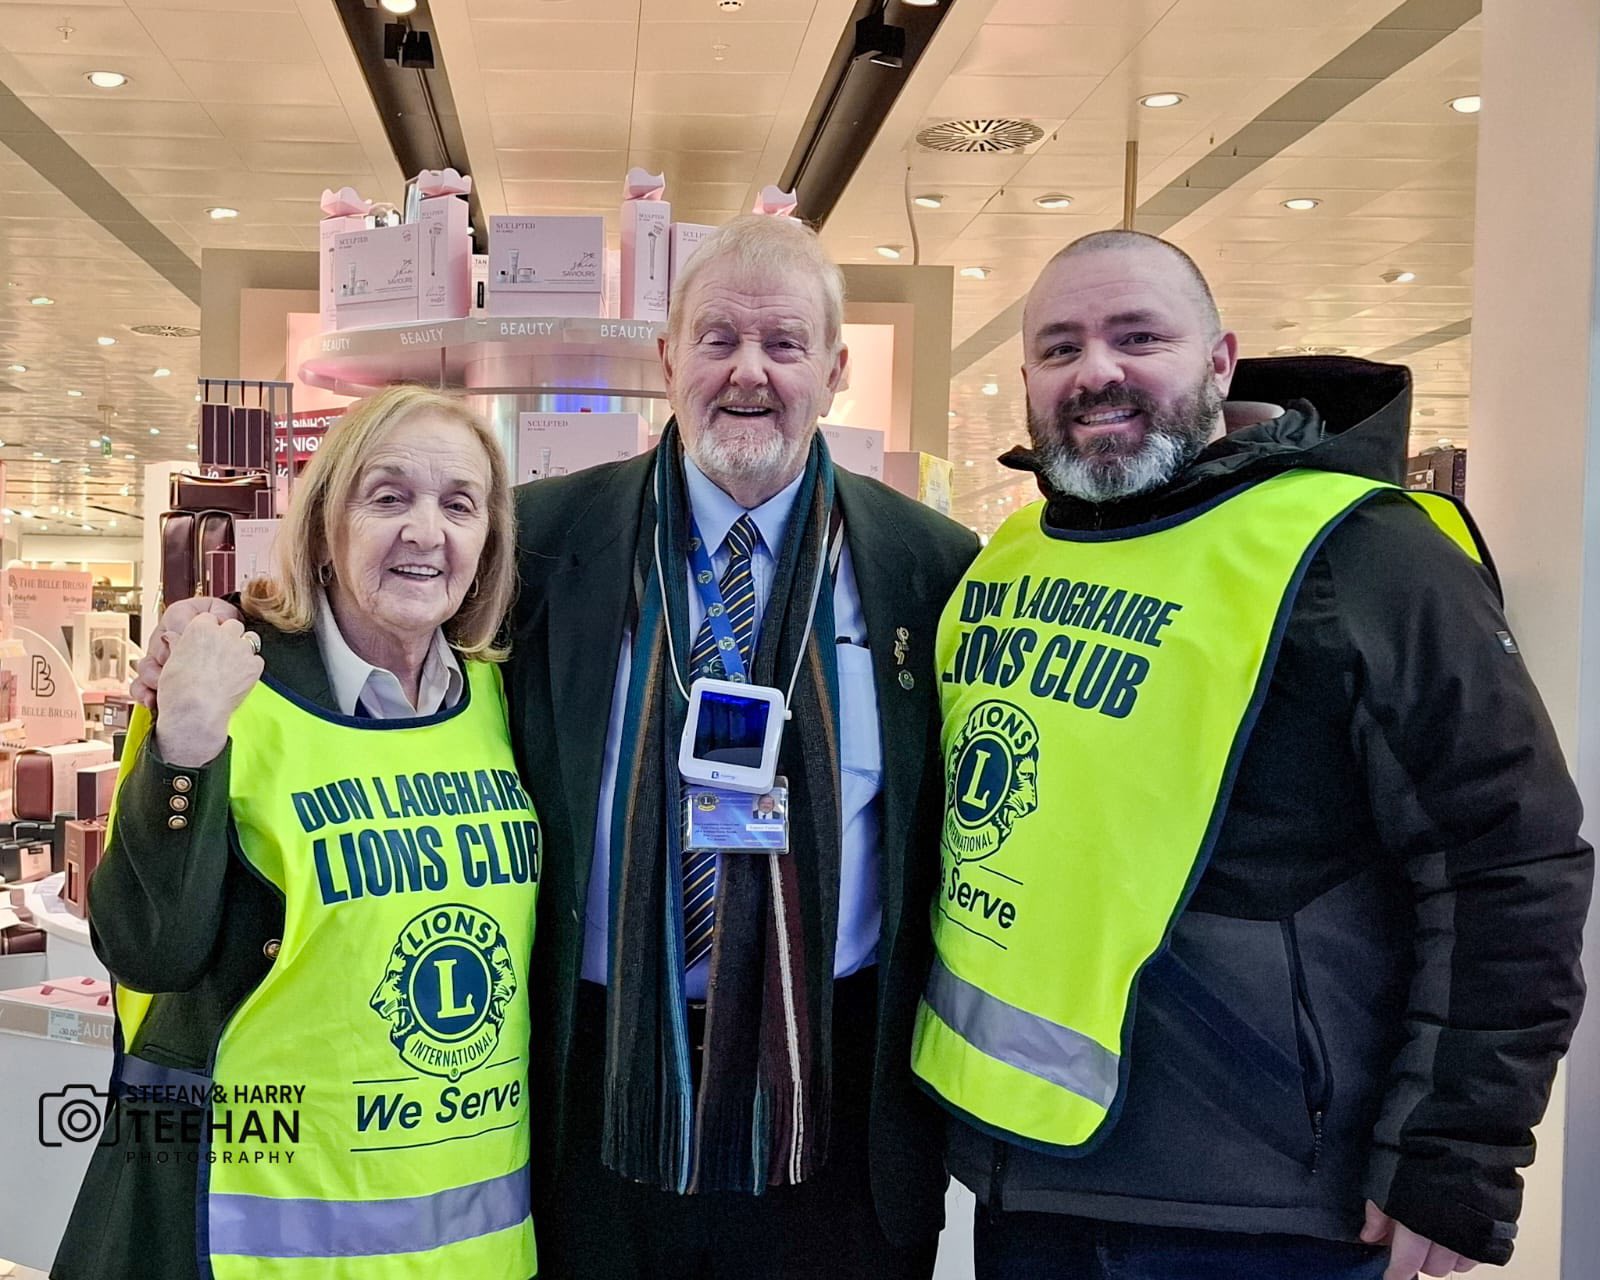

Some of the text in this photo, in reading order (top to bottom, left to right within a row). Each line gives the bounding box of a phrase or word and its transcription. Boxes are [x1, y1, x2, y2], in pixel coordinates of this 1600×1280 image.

[495, 222, 536, 230] SCULPTED
[321, 337, 351, 352] BEAUTY
[400, 328, 444, 345] BEAUTY
[500, 321, 554, 336] BEAUTY
[600, 324, 654, 339] BEAUTY
[527, 419, 568, 428] SCULPTED
[20, 577, 34, 589] THE
[37, 578, 60, 589] BELLE
[62, 579, 88, 590] BRUSH
[1013, 574, 1184, 648] LAOGHAIRE
[1029, 633, 1151, 720] CLUB
[21, 705, 78, 719] BELLE BRUSH
[970, 706, 1033, 750] LIONS
[962, 749, 991, 810] L
[291, 767, 530, 834] DUN LAOGHAIR
[312, 820, 540, 906] LIONS CLUB
[947, 866, 1017, 929] Serve
[406, 910, 493, 951] LIONS
[433, 958, 476, 1019] L
[79, 1021, 114, 1040] AUT
[409, 1031, 495, 1068] INTERNATIONAL
[356, 1079, 521, 1133] We Serve
